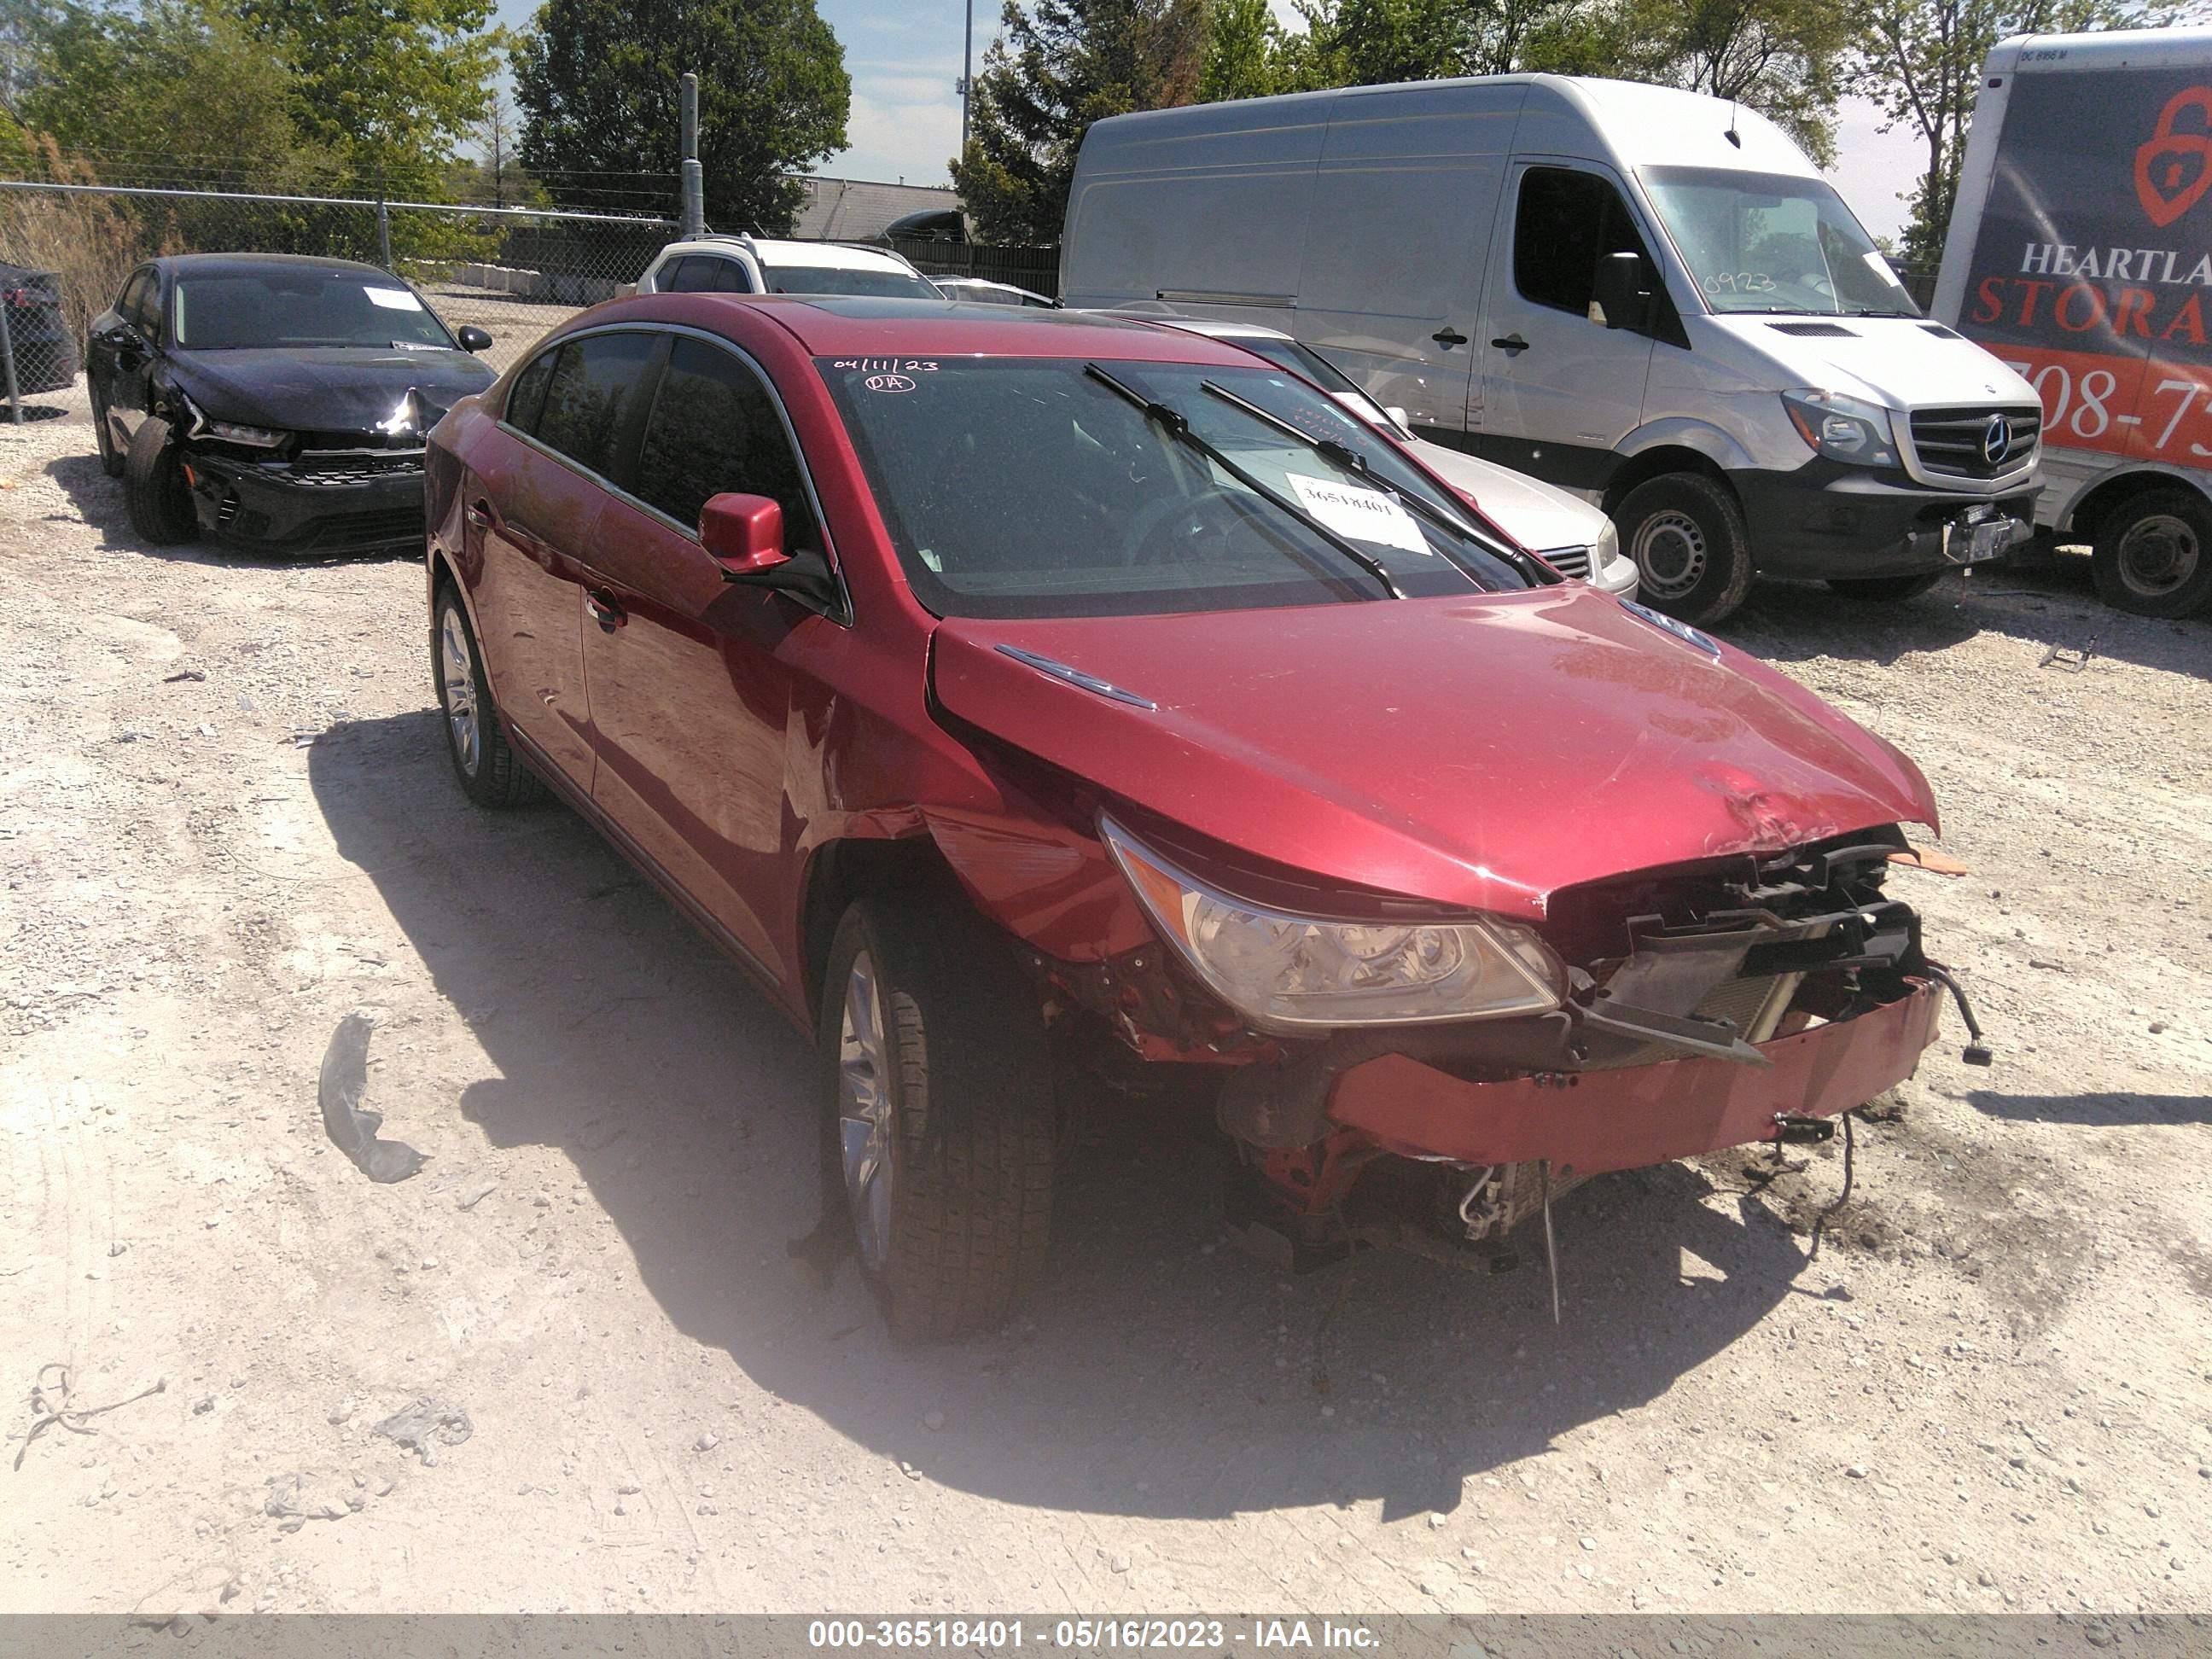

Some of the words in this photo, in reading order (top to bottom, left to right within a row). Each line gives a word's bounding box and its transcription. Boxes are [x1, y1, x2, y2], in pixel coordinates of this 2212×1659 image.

[2019, 242, 2212, 286] HEARTLA
[1703, 272, 1778, 294] 0923
[1971, 276, 2209, 345] STORA
[833, 358, 939, 374] 04/11/23
[2003, 360, 2212, 457] 08-7
[1303, 486, 1393, 516] 36518401
